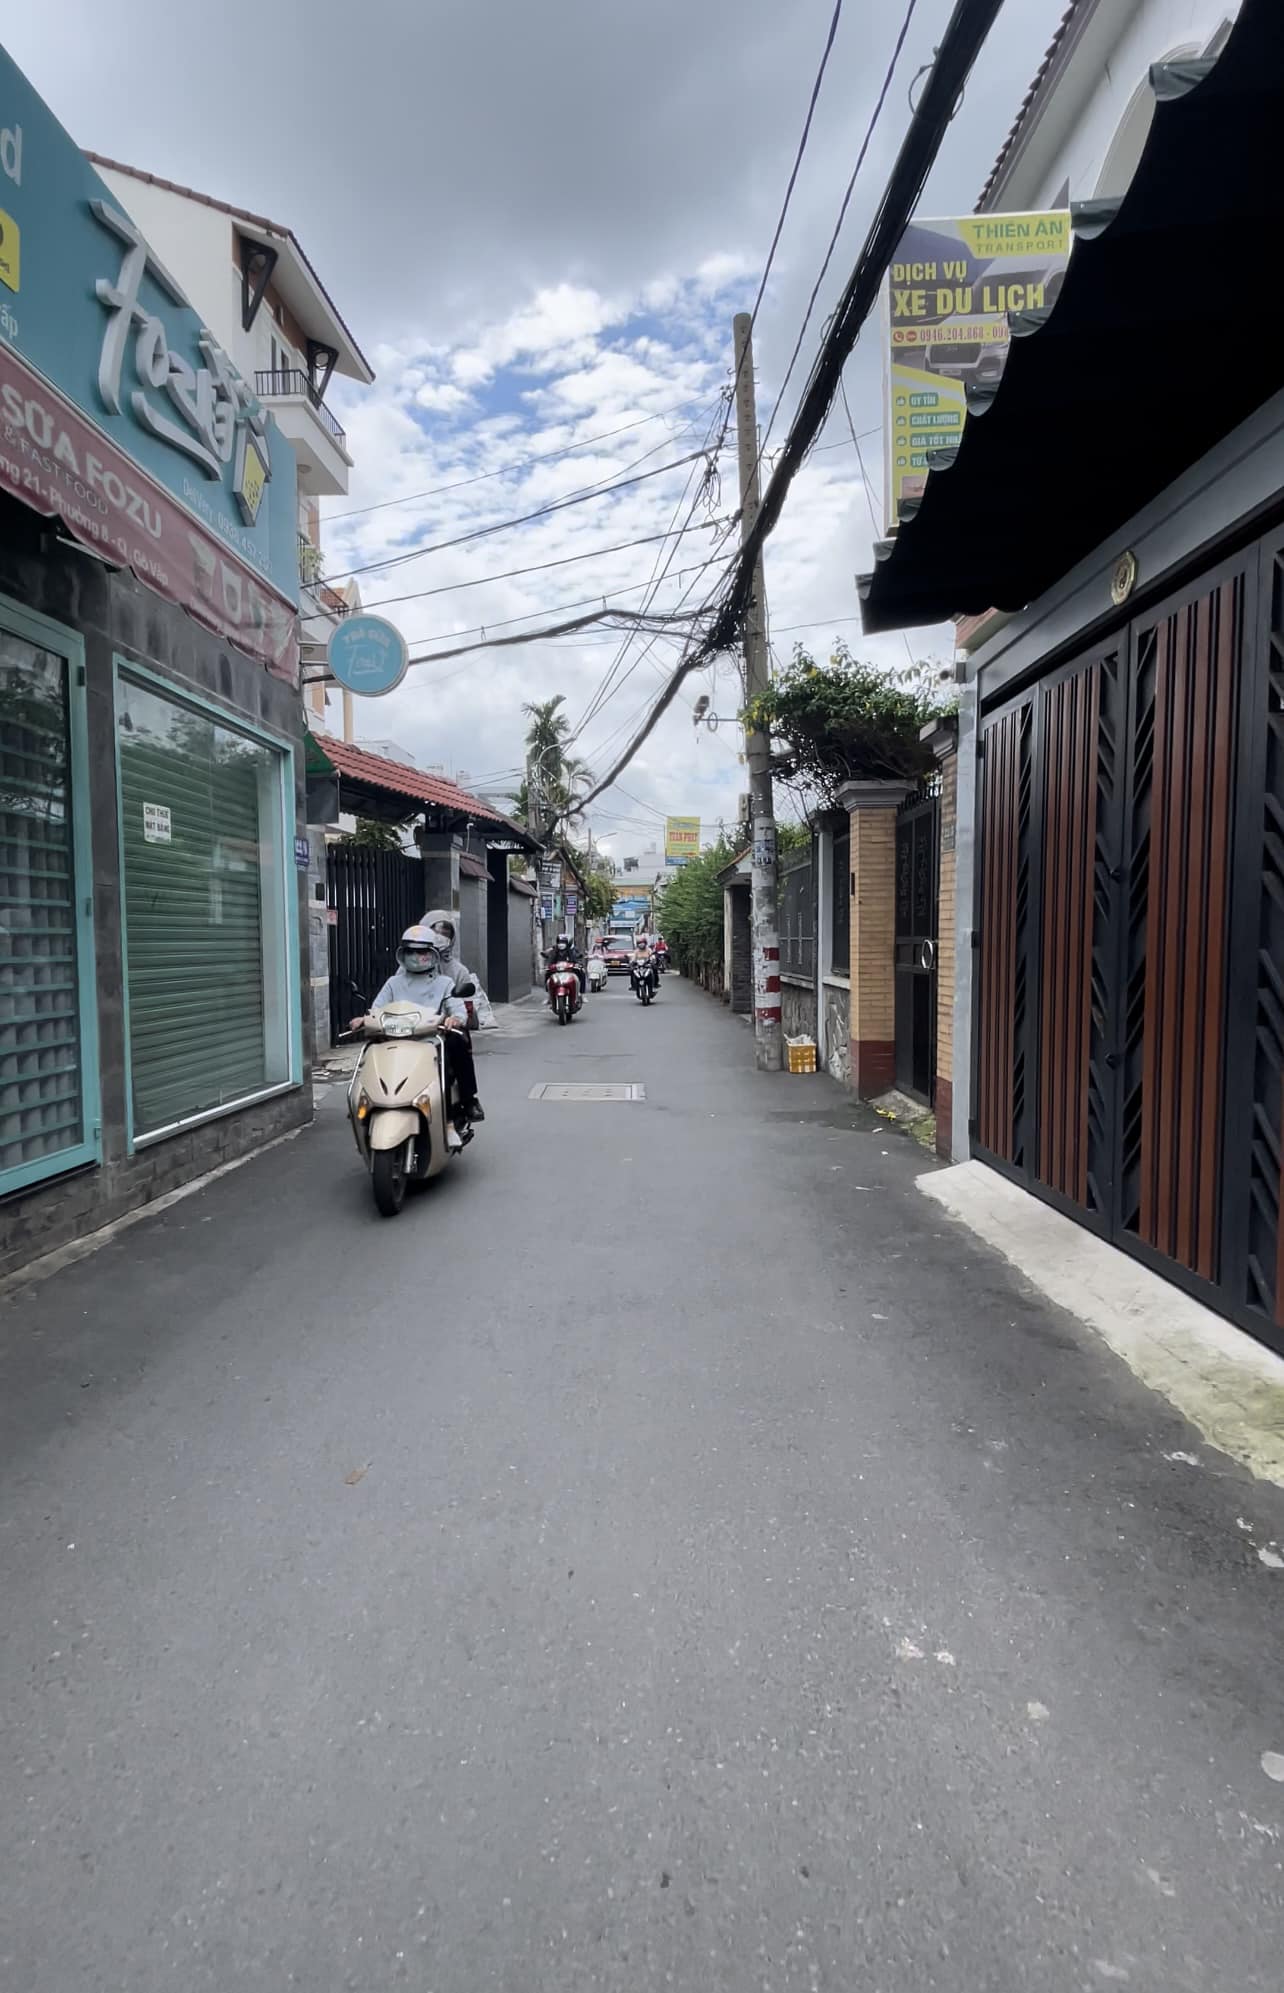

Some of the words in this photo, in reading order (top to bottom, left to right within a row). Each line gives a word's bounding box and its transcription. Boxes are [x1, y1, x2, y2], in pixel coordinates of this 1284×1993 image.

[976, 239, 1063, 254] TRANSPORT
[892, 262, 937, 286] DỊCH
[943, 260, 968, 283] VỤ
[894, 289, 927, 317] XE
[936, 287, 972, 315] DU
[20, 438, 61, 479] FAST
[65, 472, 109, 515] FOOD
[86, 451, 162, 539] FOZU
